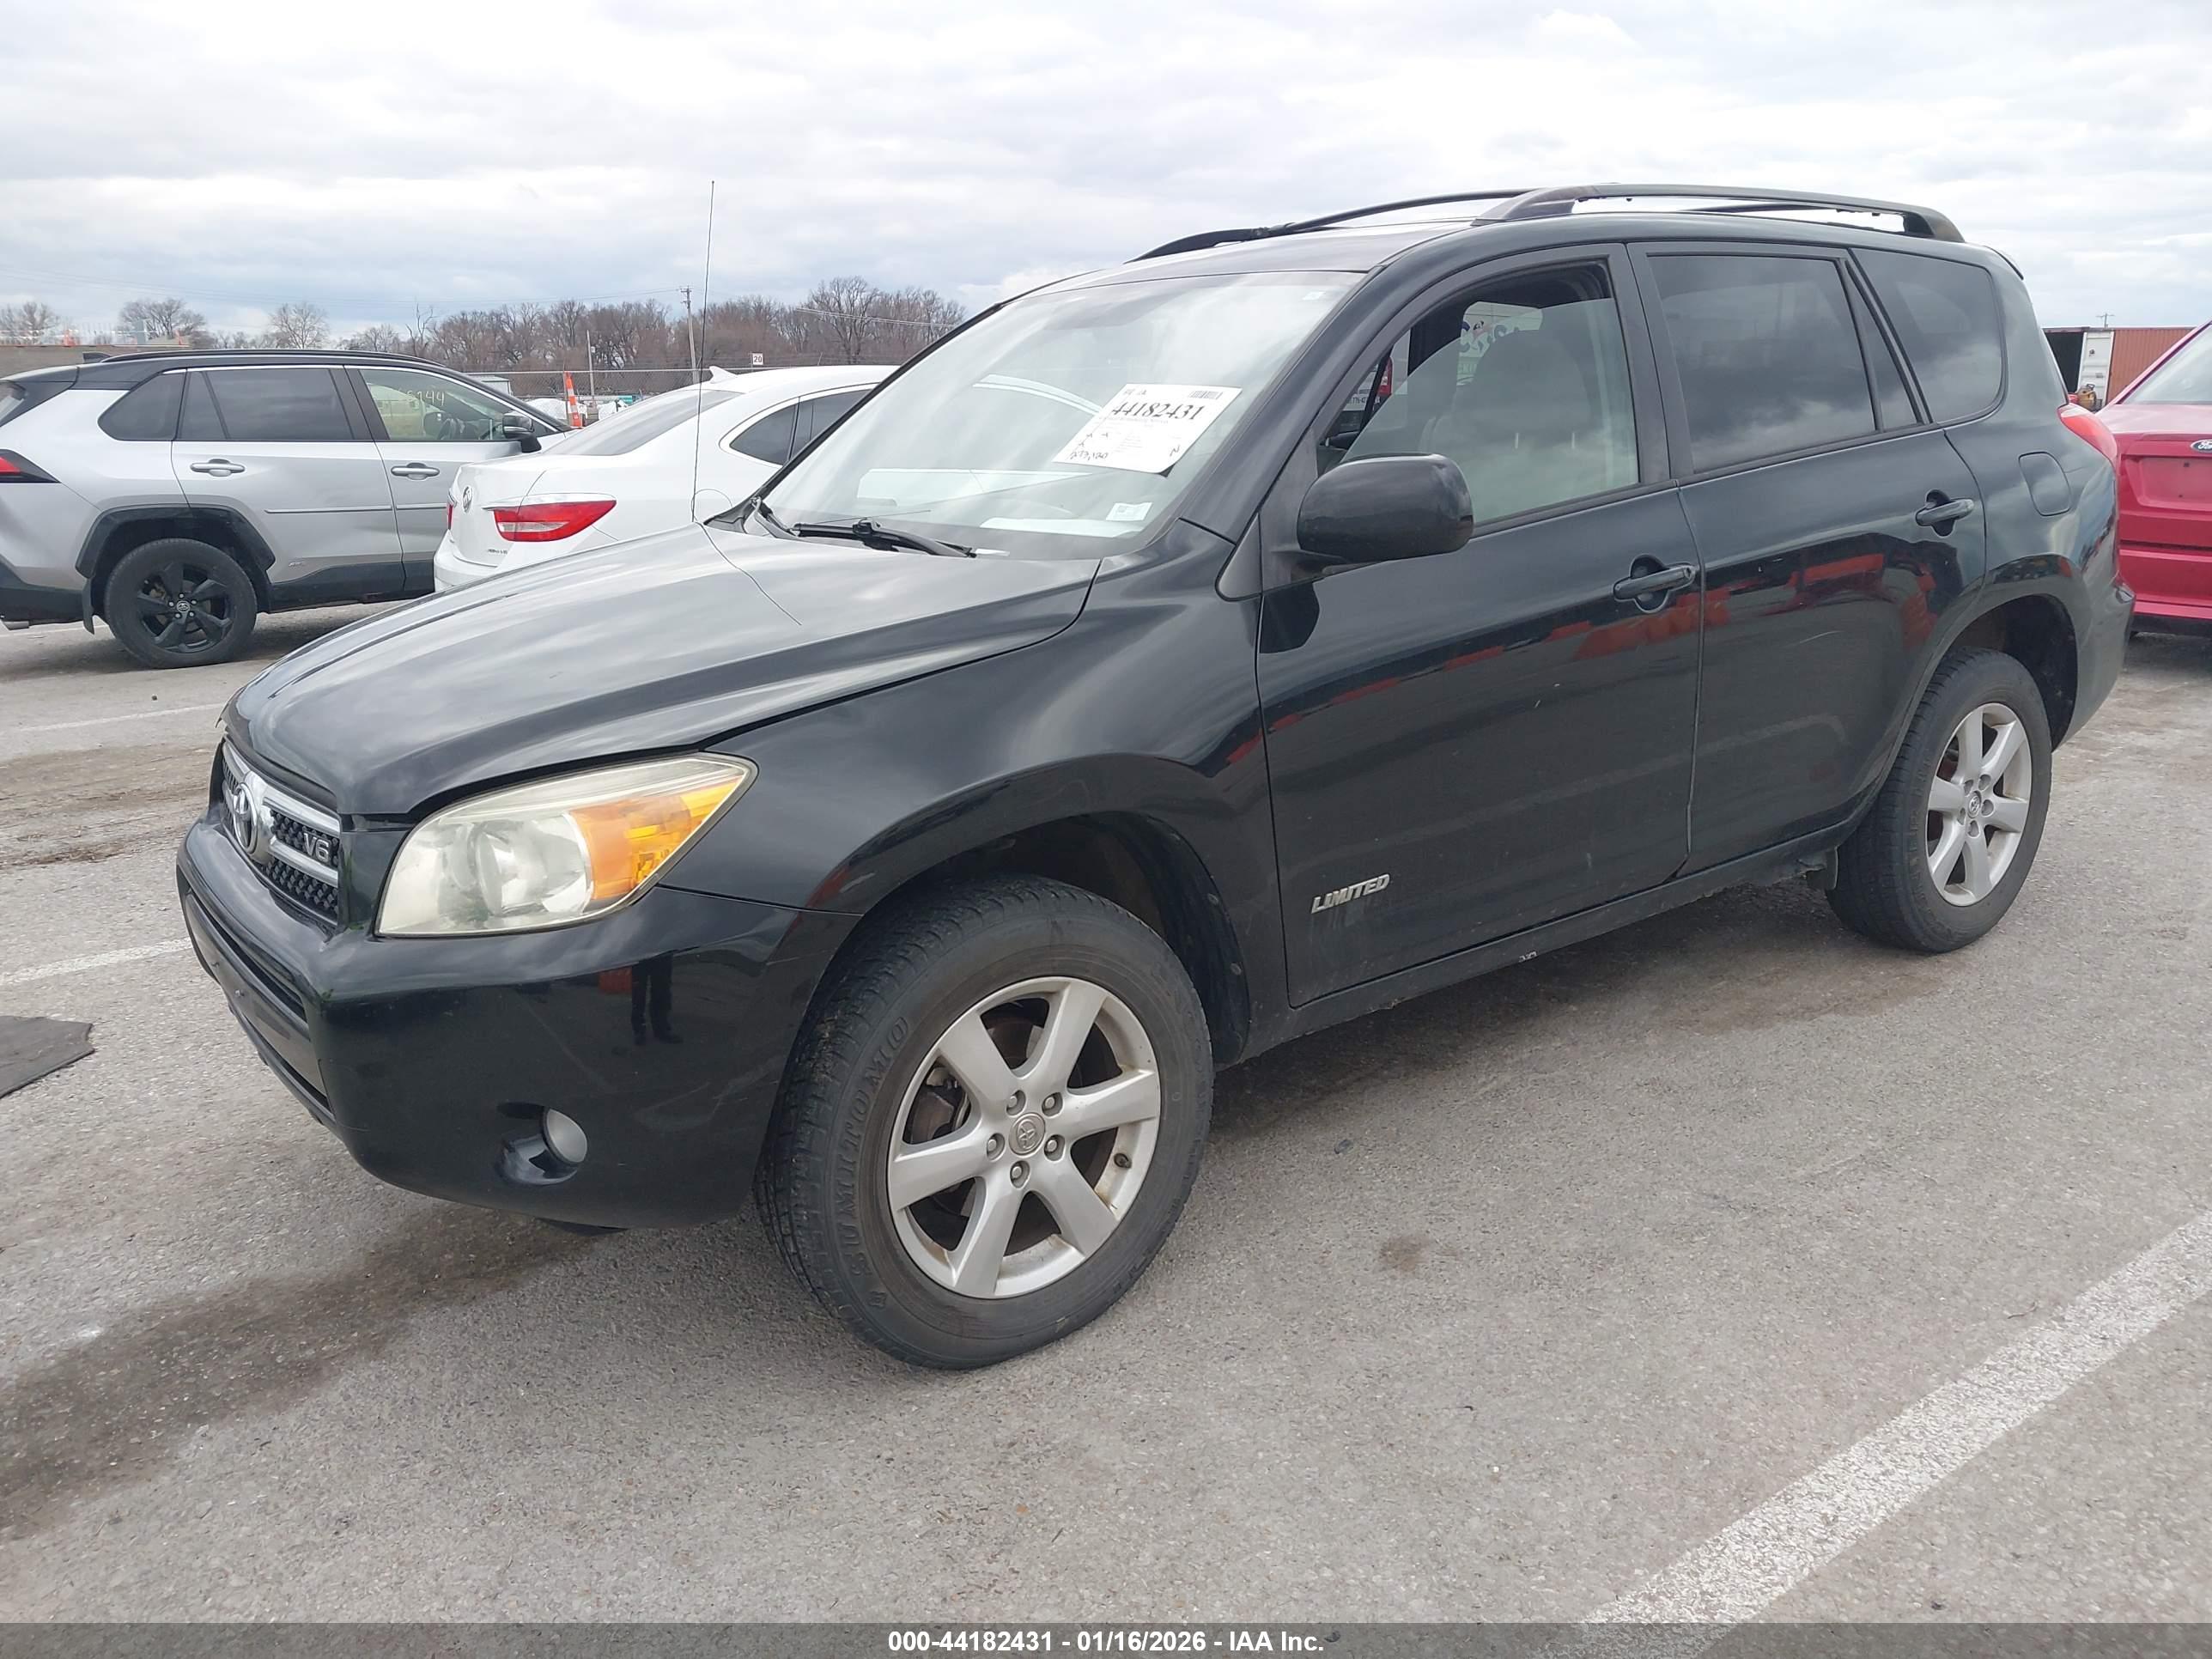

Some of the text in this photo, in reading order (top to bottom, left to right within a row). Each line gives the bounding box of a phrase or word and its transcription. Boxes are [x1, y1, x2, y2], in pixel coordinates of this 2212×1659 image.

[1112, 401, 1205, 420] 44182431
[303, 833, 329, 862] V6
[1310, 873, 1390, 915] LIMITED
[837, 1016, 910, 1277] SUMITOMO
